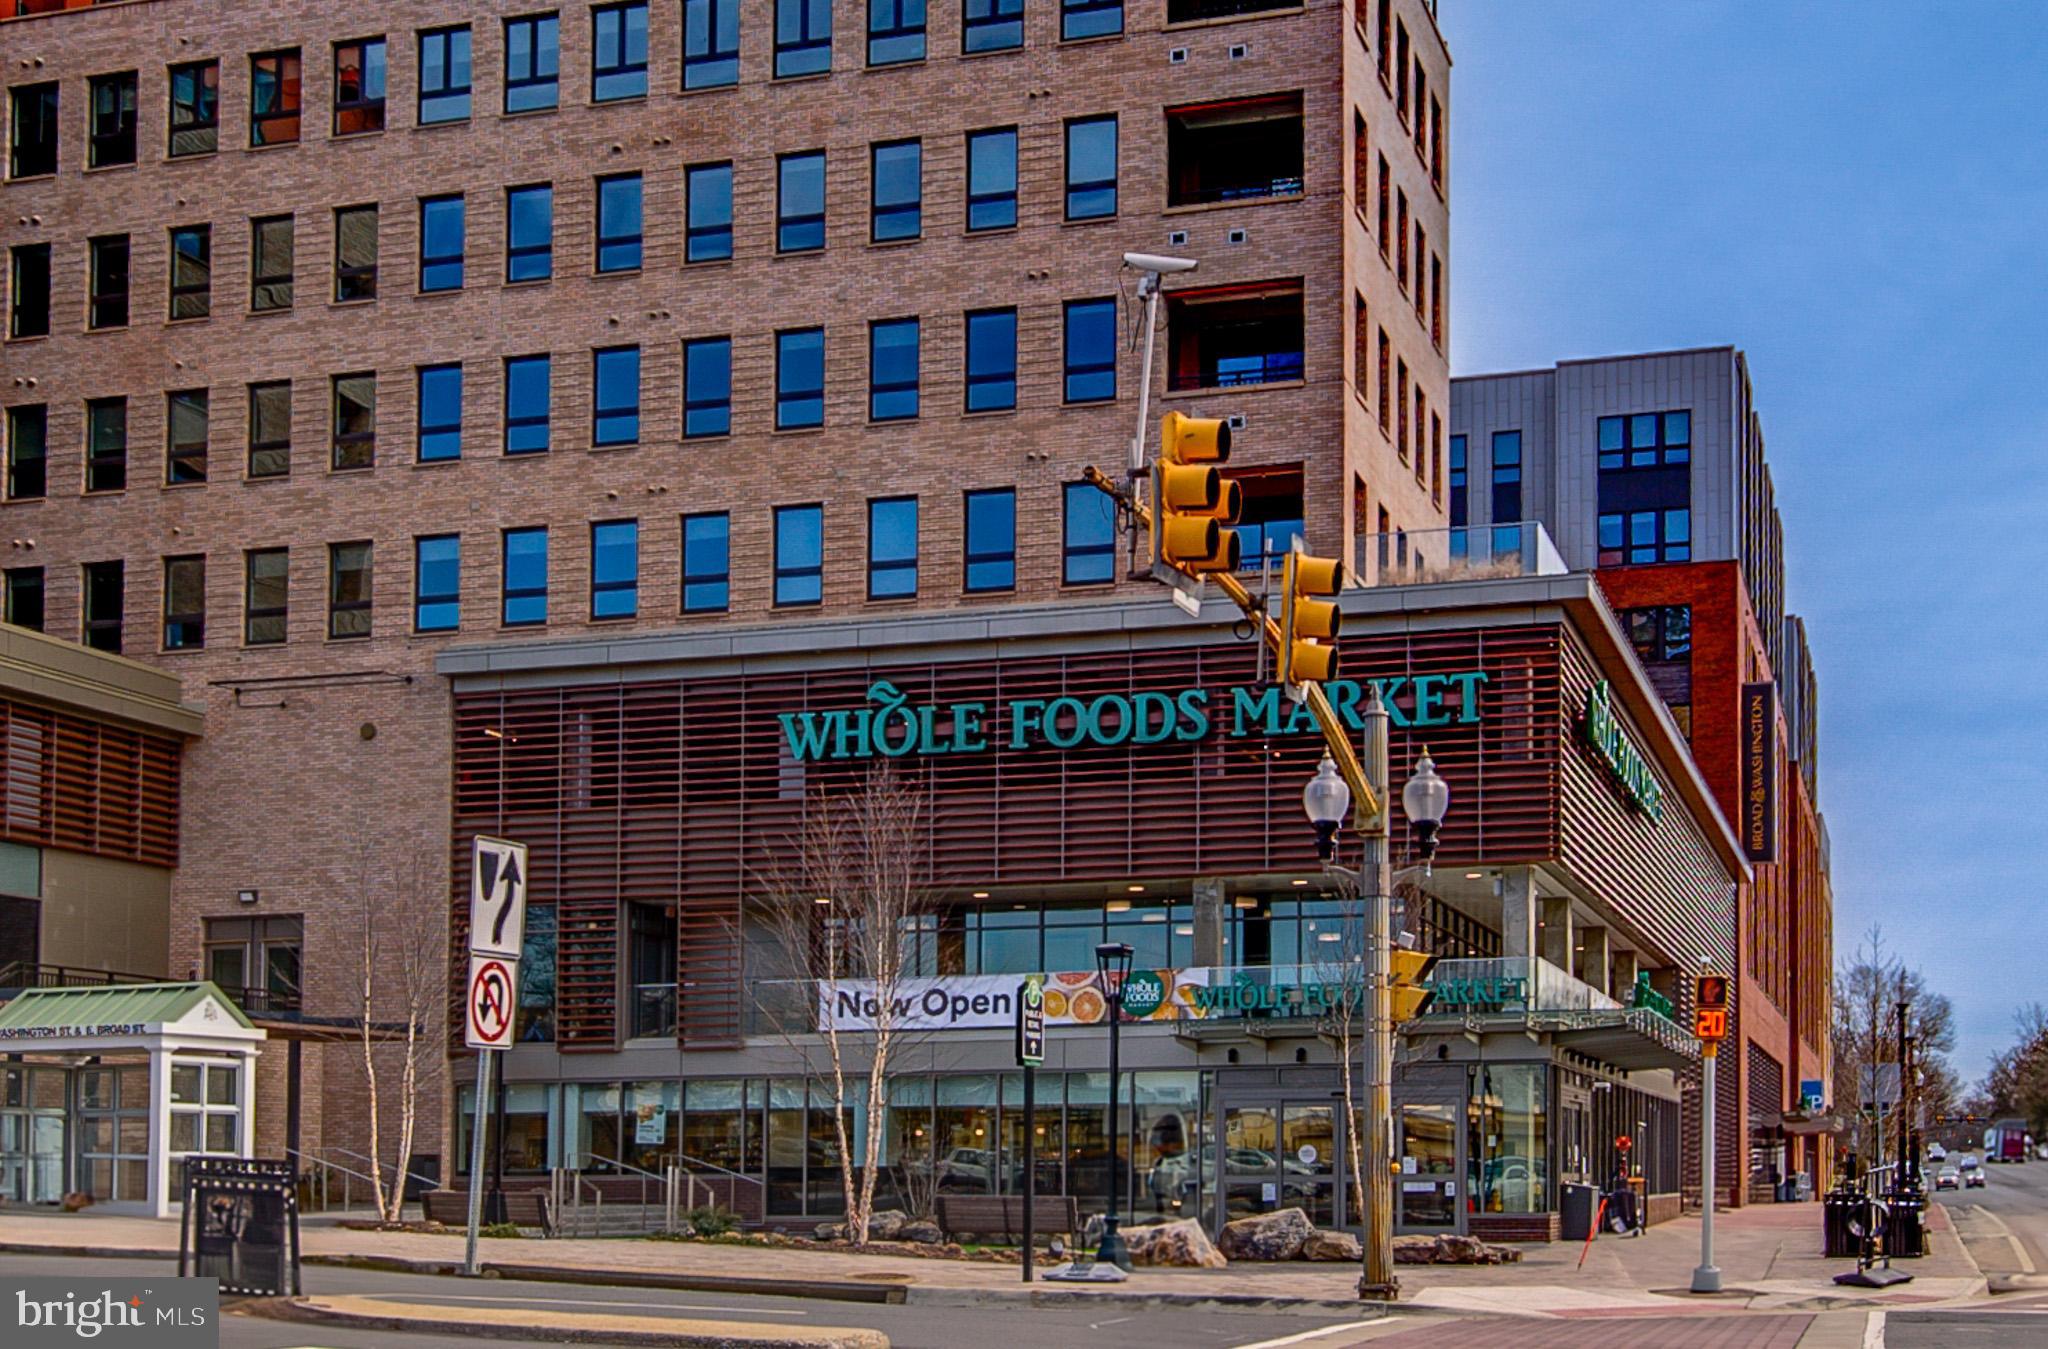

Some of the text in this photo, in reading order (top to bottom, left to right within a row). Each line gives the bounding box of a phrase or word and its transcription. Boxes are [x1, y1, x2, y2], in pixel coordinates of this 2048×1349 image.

[777, 672, 1488, 760] WHOLE FOODS MARKET
[1751, 804, 1764, 850] BROAD
[838, 988, 1010, 1022] Now Open
[1191, 972, 1529, 1010] WHOLE FOO ARKET
[0, 1028, 56, 1038] ASHINGTON
[1698, 1011, 1725, 1037] 20
